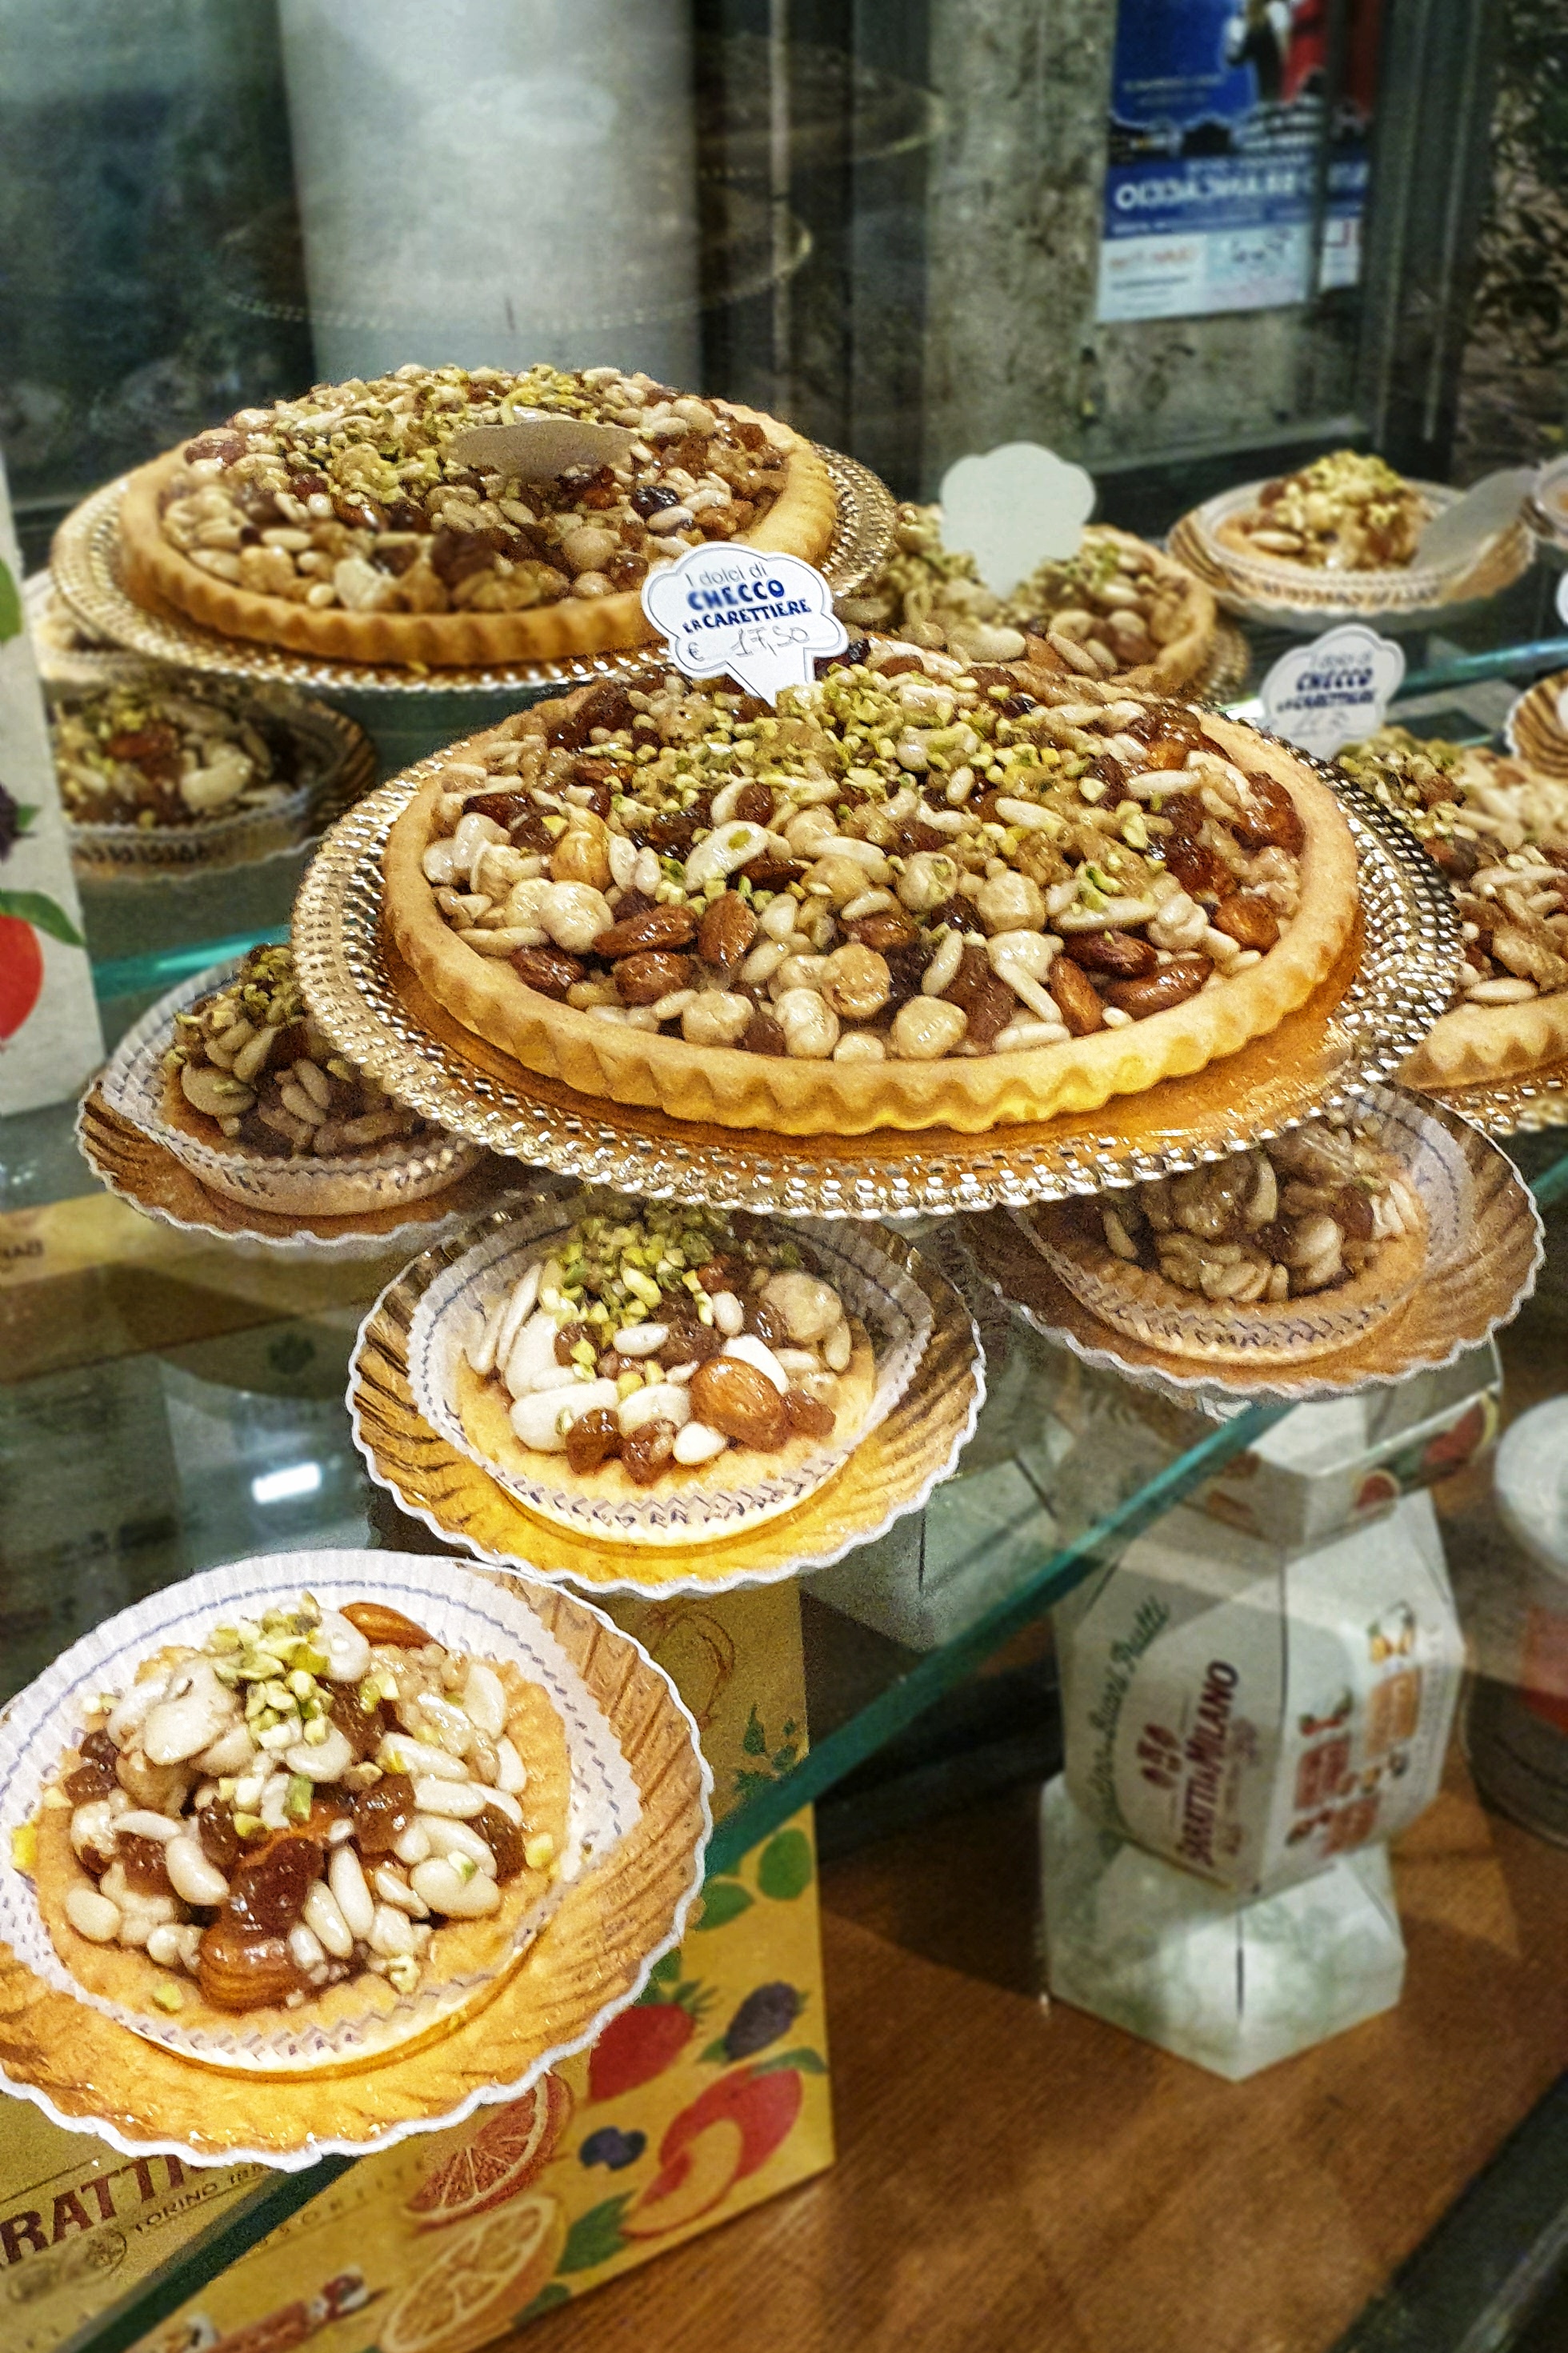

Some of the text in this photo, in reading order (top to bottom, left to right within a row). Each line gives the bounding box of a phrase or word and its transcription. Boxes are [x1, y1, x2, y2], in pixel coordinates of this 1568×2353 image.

[699, 565, 745, 586] dolci
[750, 562, 769, 579] di
[686, 579, 785, 610] CHECCO
[702, 598, 812, 629] CARETTIERE
[0, 2155, 185, 2265] RATTI
